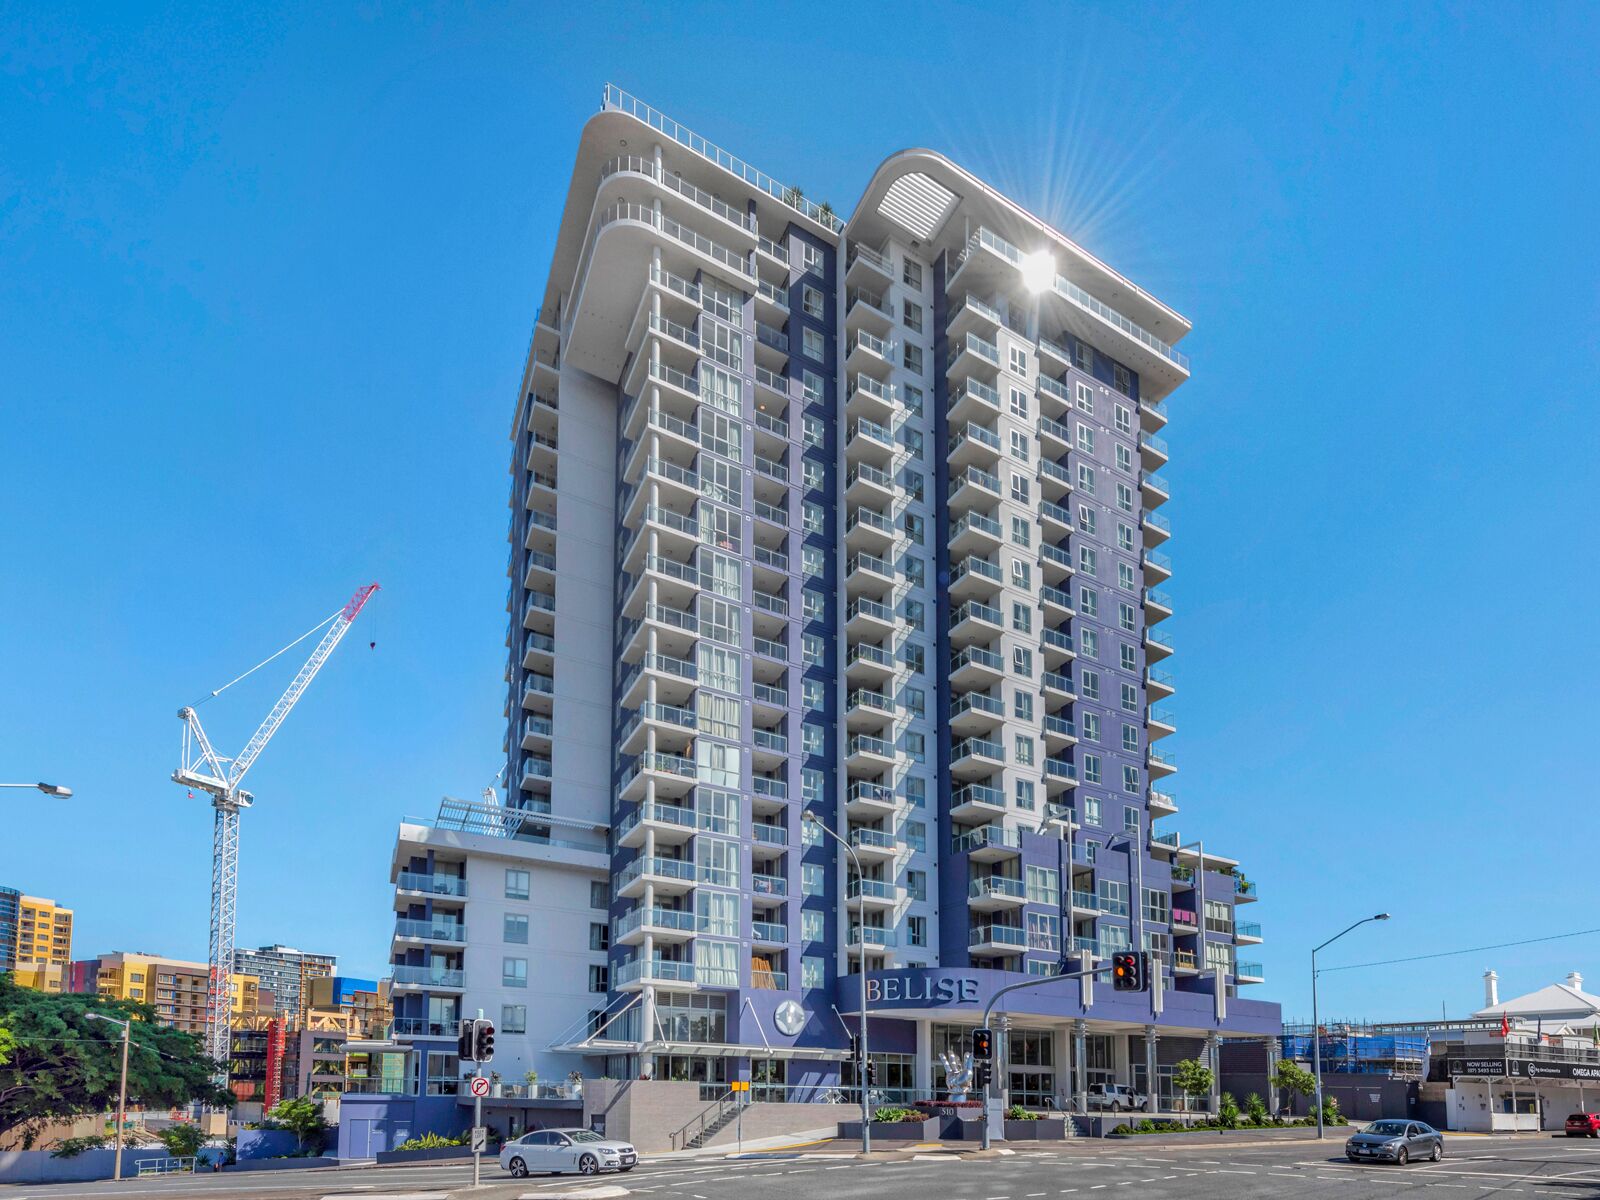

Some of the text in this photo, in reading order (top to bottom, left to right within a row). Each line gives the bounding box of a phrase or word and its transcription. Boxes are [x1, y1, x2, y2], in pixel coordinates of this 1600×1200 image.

[867, 977, 979, 1002] BELISE
[1572, 1068, 1590, 1076] OMEGA
[941, 1107, 954, 1115] 510
